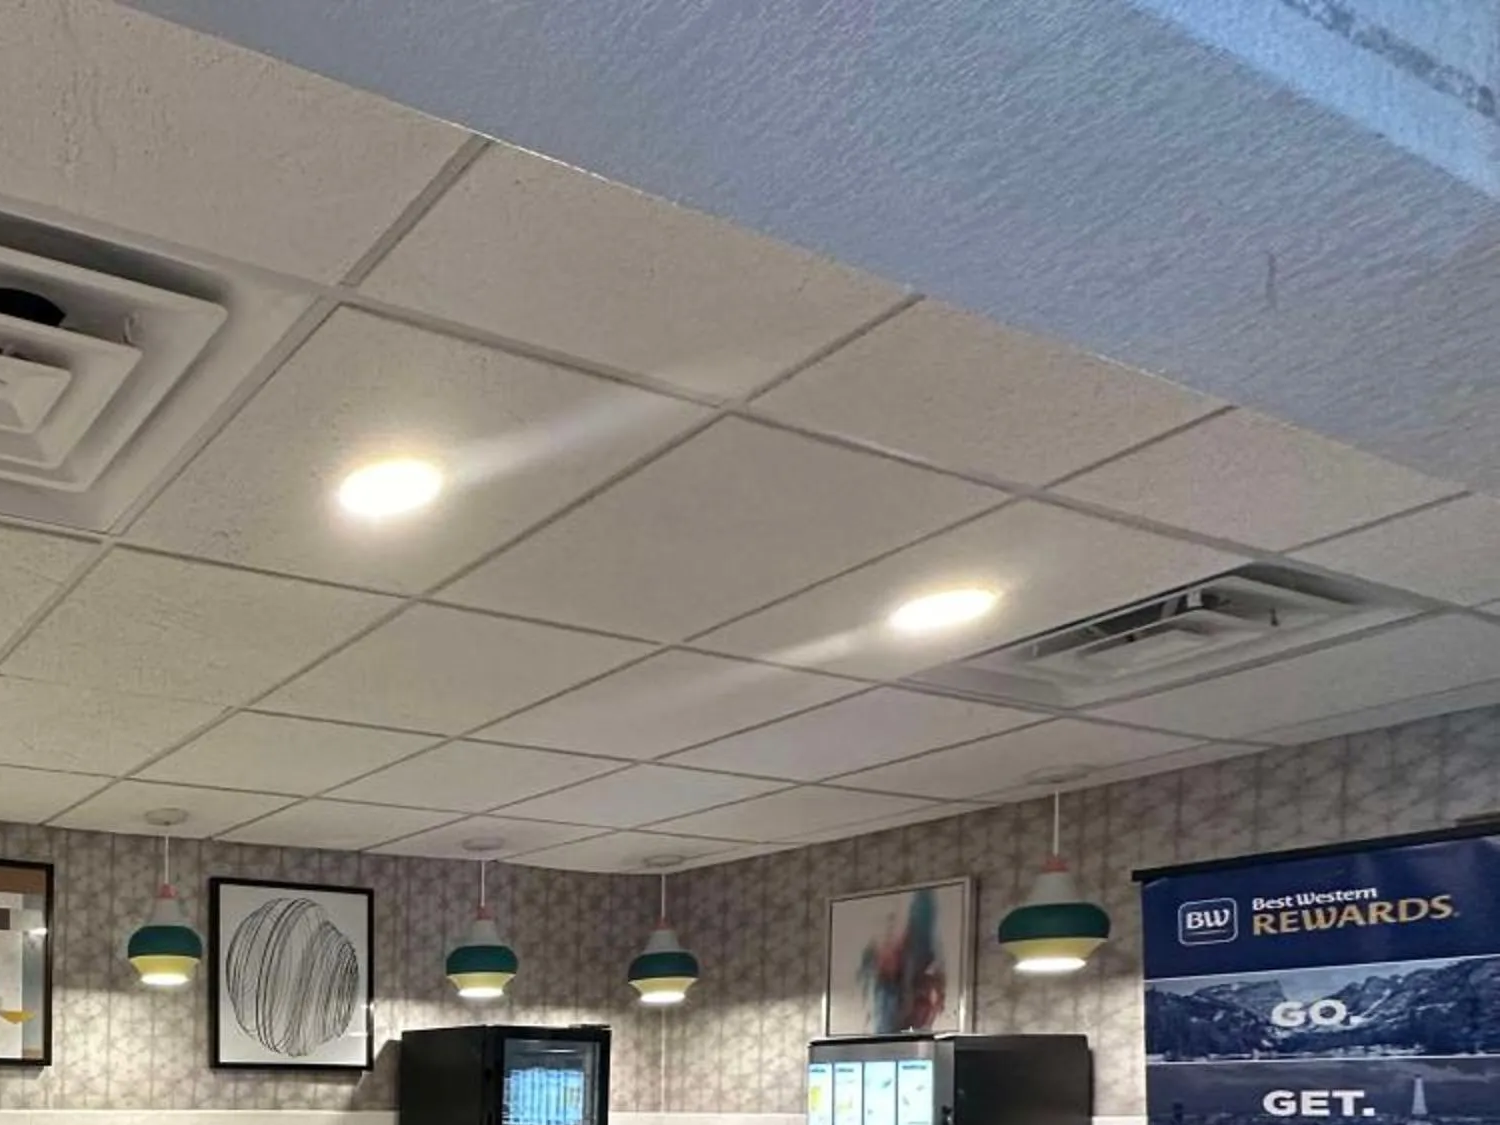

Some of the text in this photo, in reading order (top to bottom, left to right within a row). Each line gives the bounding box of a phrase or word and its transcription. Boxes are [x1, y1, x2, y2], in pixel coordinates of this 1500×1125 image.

[1253, 887, 1378, 911] Best Western
[1186, 908, 1230, 930] BW
[1253, 894, 1454, 936] REWARDS
[1271, 999, 1362, 1027] GO.
[1263, 1089, 1375, 1117] GET.
